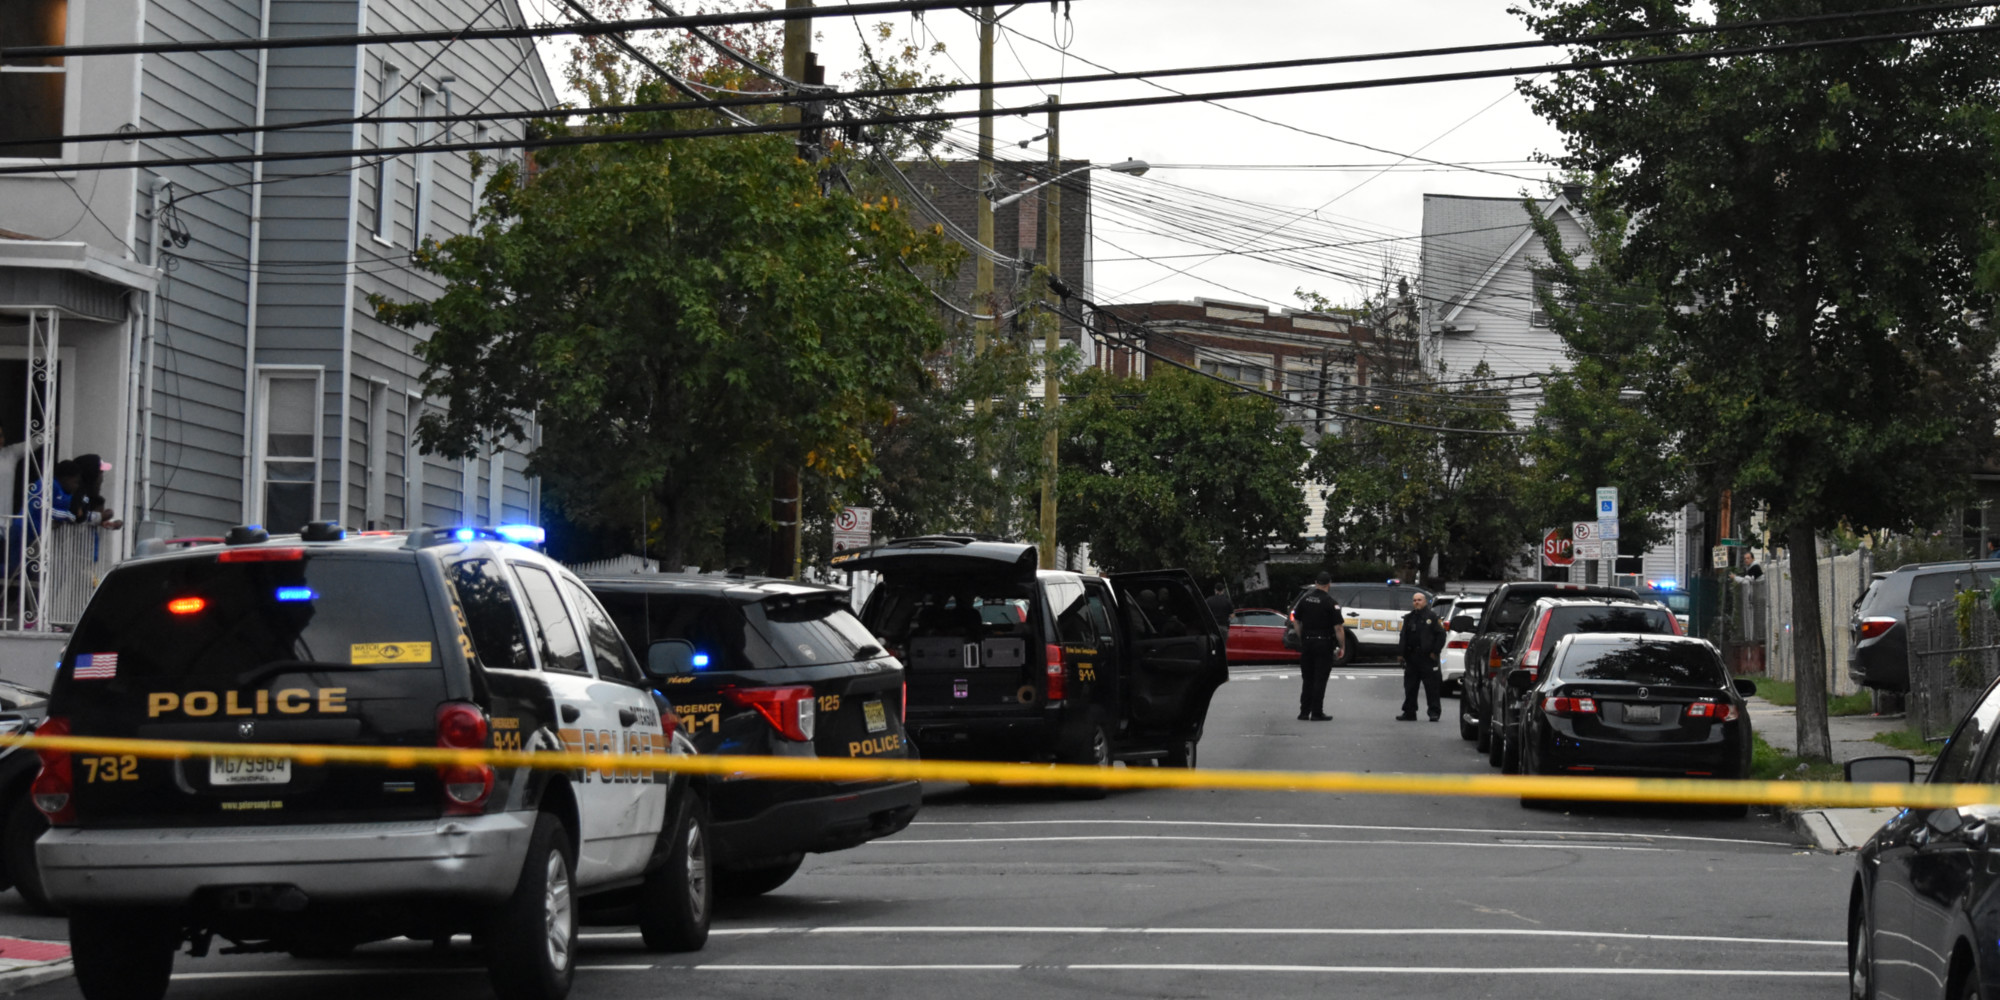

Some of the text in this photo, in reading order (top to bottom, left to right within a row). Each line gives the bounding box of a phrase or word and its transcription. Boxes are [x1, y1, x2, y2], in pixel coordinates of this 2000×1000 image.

[1360, 618, 1403, 633] POLI
[148, 687, 348, 718] POLICE
[817, 694, 840, 712] 125
[849, 734, 900, 758] POLICE
[82, 754, 139, 783] 732
